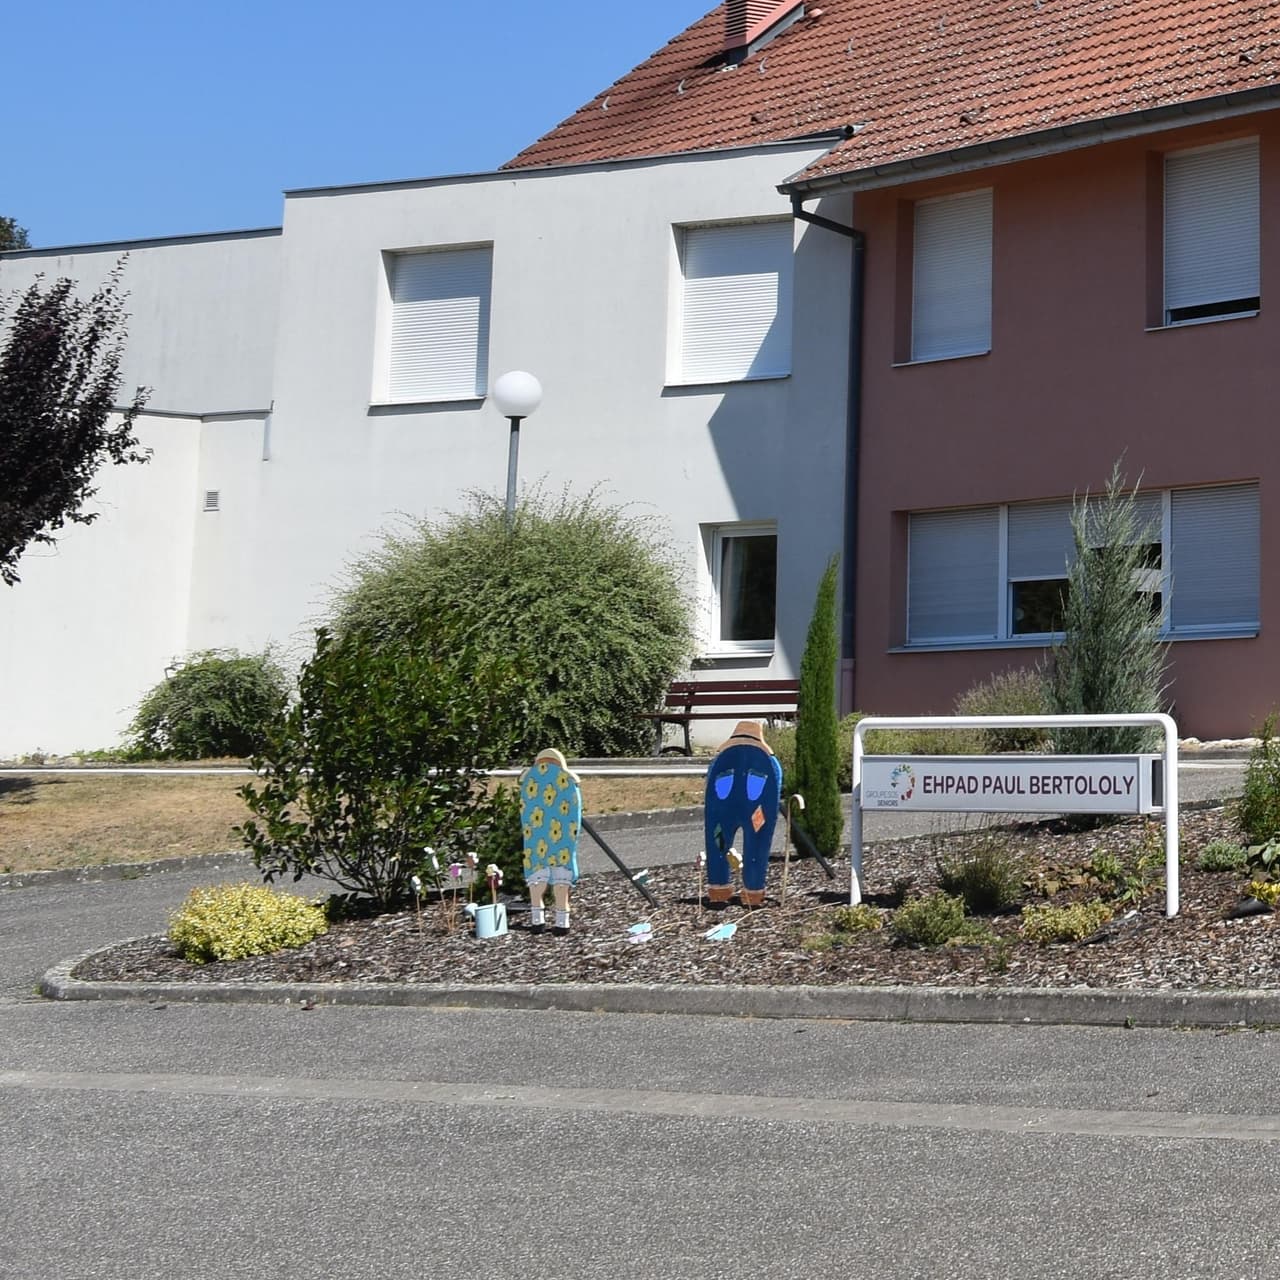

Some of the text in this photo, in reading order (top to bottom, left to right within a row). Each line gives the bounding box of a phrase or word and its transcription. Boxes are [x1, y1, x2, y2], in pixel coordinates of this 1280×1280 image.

[922, 775, 1135, 795] EHPAD PAUL BERTOLOLY
